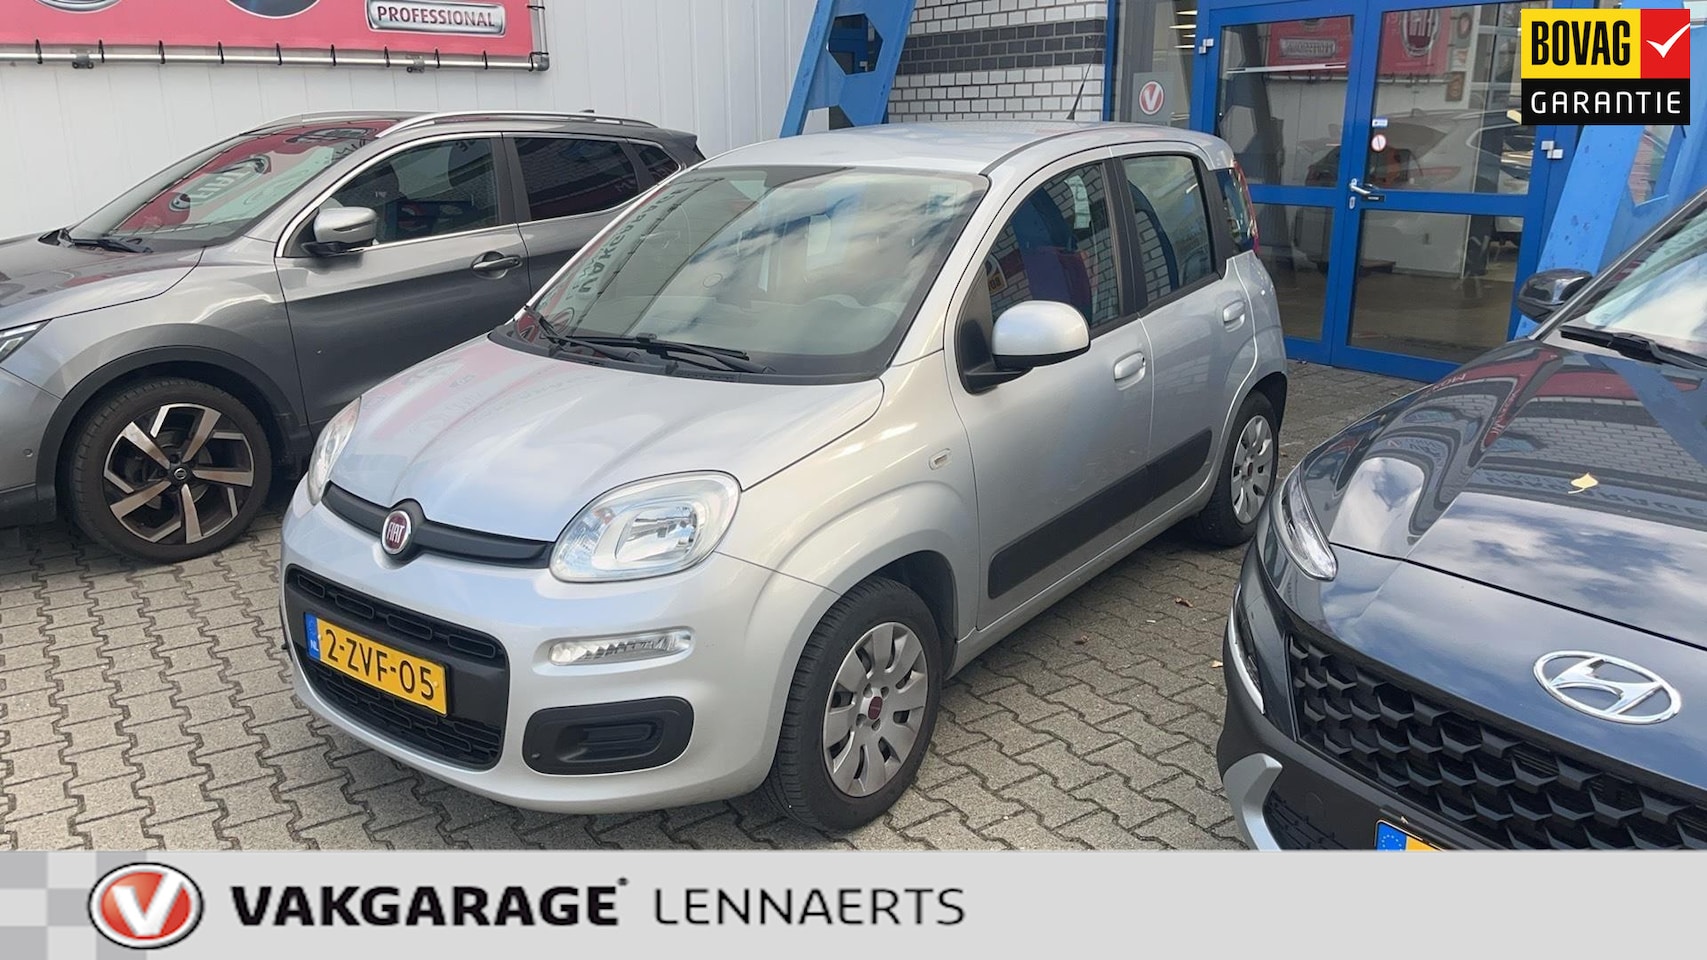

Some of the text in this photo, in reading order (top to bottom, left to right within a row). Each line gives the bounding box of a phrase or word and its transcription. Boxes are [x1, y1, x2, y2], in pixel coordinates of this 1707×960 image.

[377, 6, 495, 27] PROFESSIONAL
[387, 522, 405, 543] FIAT
[325, 629, 434, 700] 2-ZVF-05
